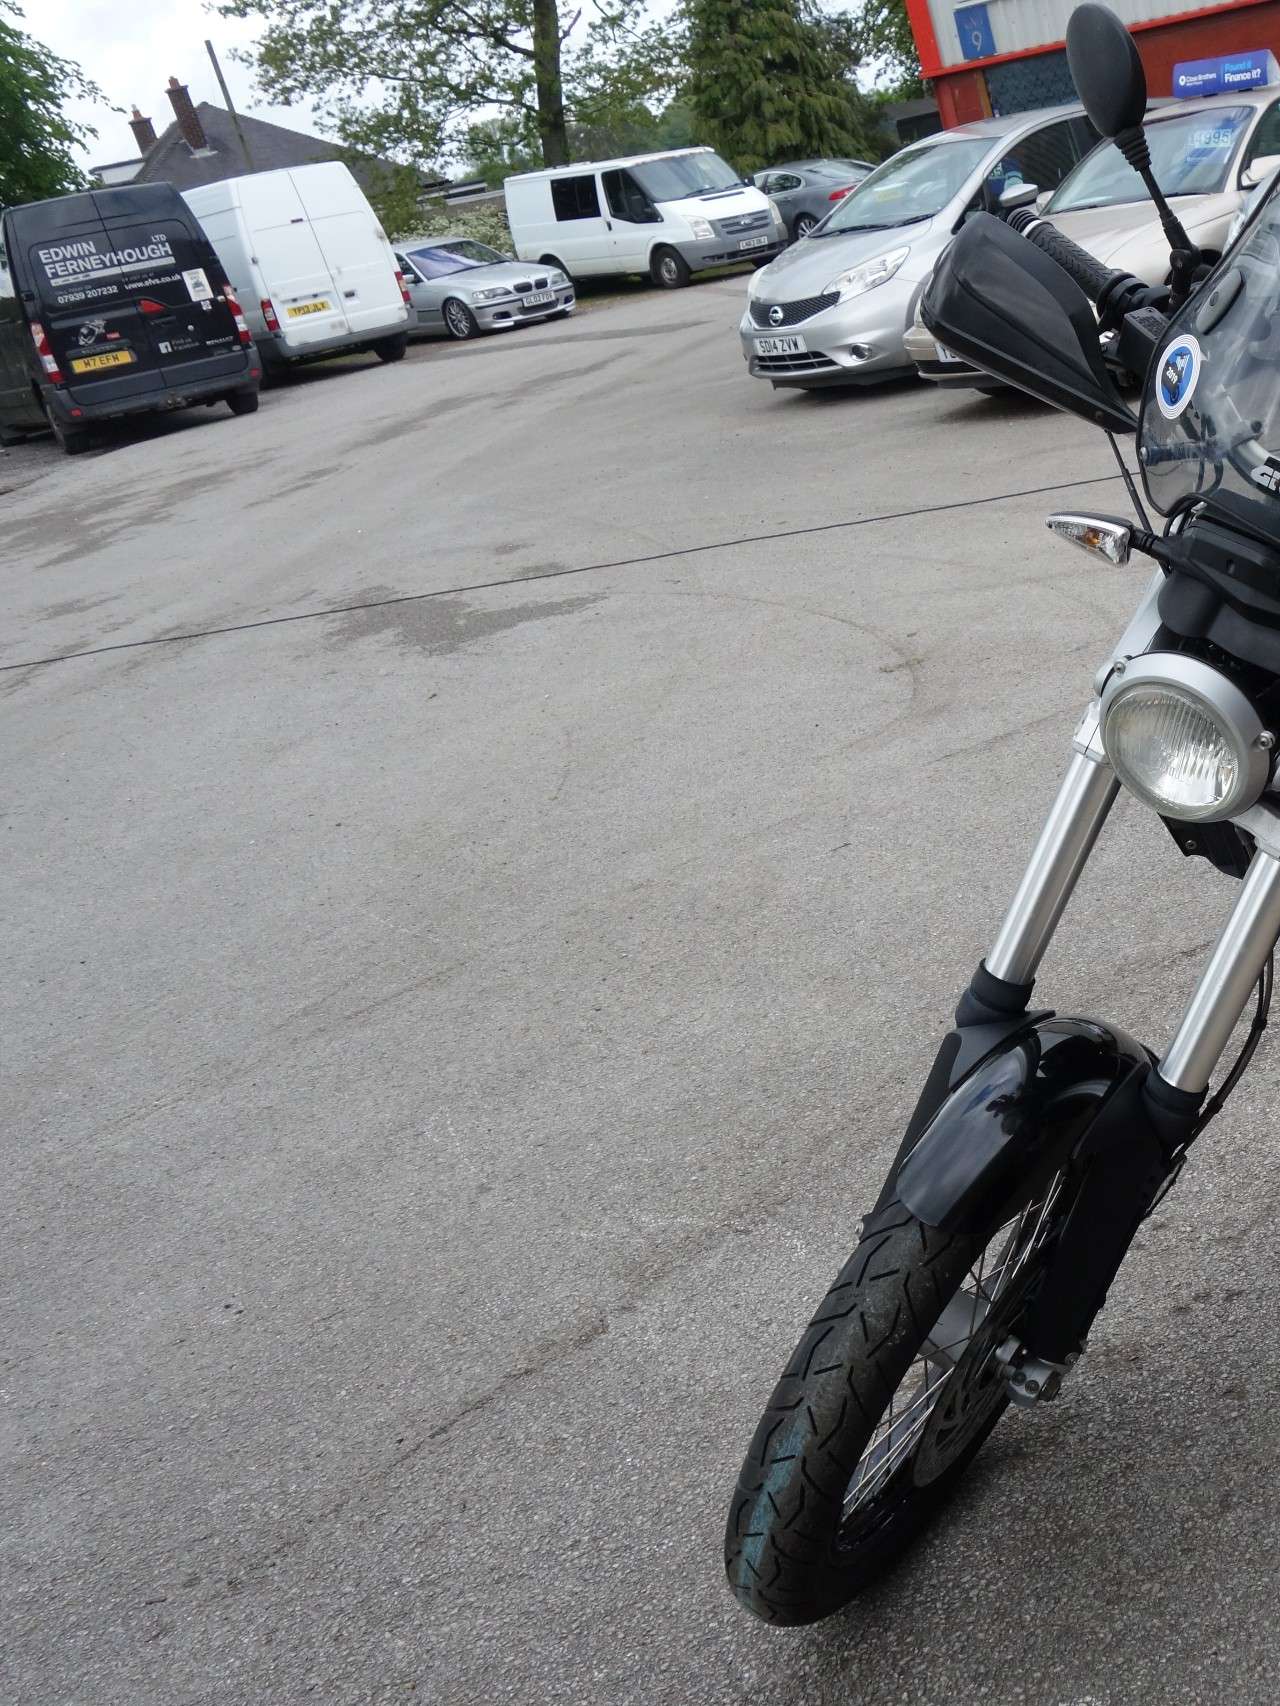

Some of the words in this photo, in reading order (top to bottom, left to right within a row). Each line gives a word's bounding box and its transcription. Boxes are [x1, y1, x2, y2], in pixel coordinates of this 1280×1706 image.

[972, 31, 982, 52] 9
[1224, 72, 1251, 83] Finance
[151, 234, 167, 242] LTD
[38, 241, 96, 263] EDWIN
[44, 242, 173, 278] FERNEYHOUGH
[57, 290, 86, 304] 07939
[87, 285, 118, 298] 207232
[1166, 366, 1179, 385] 2019
